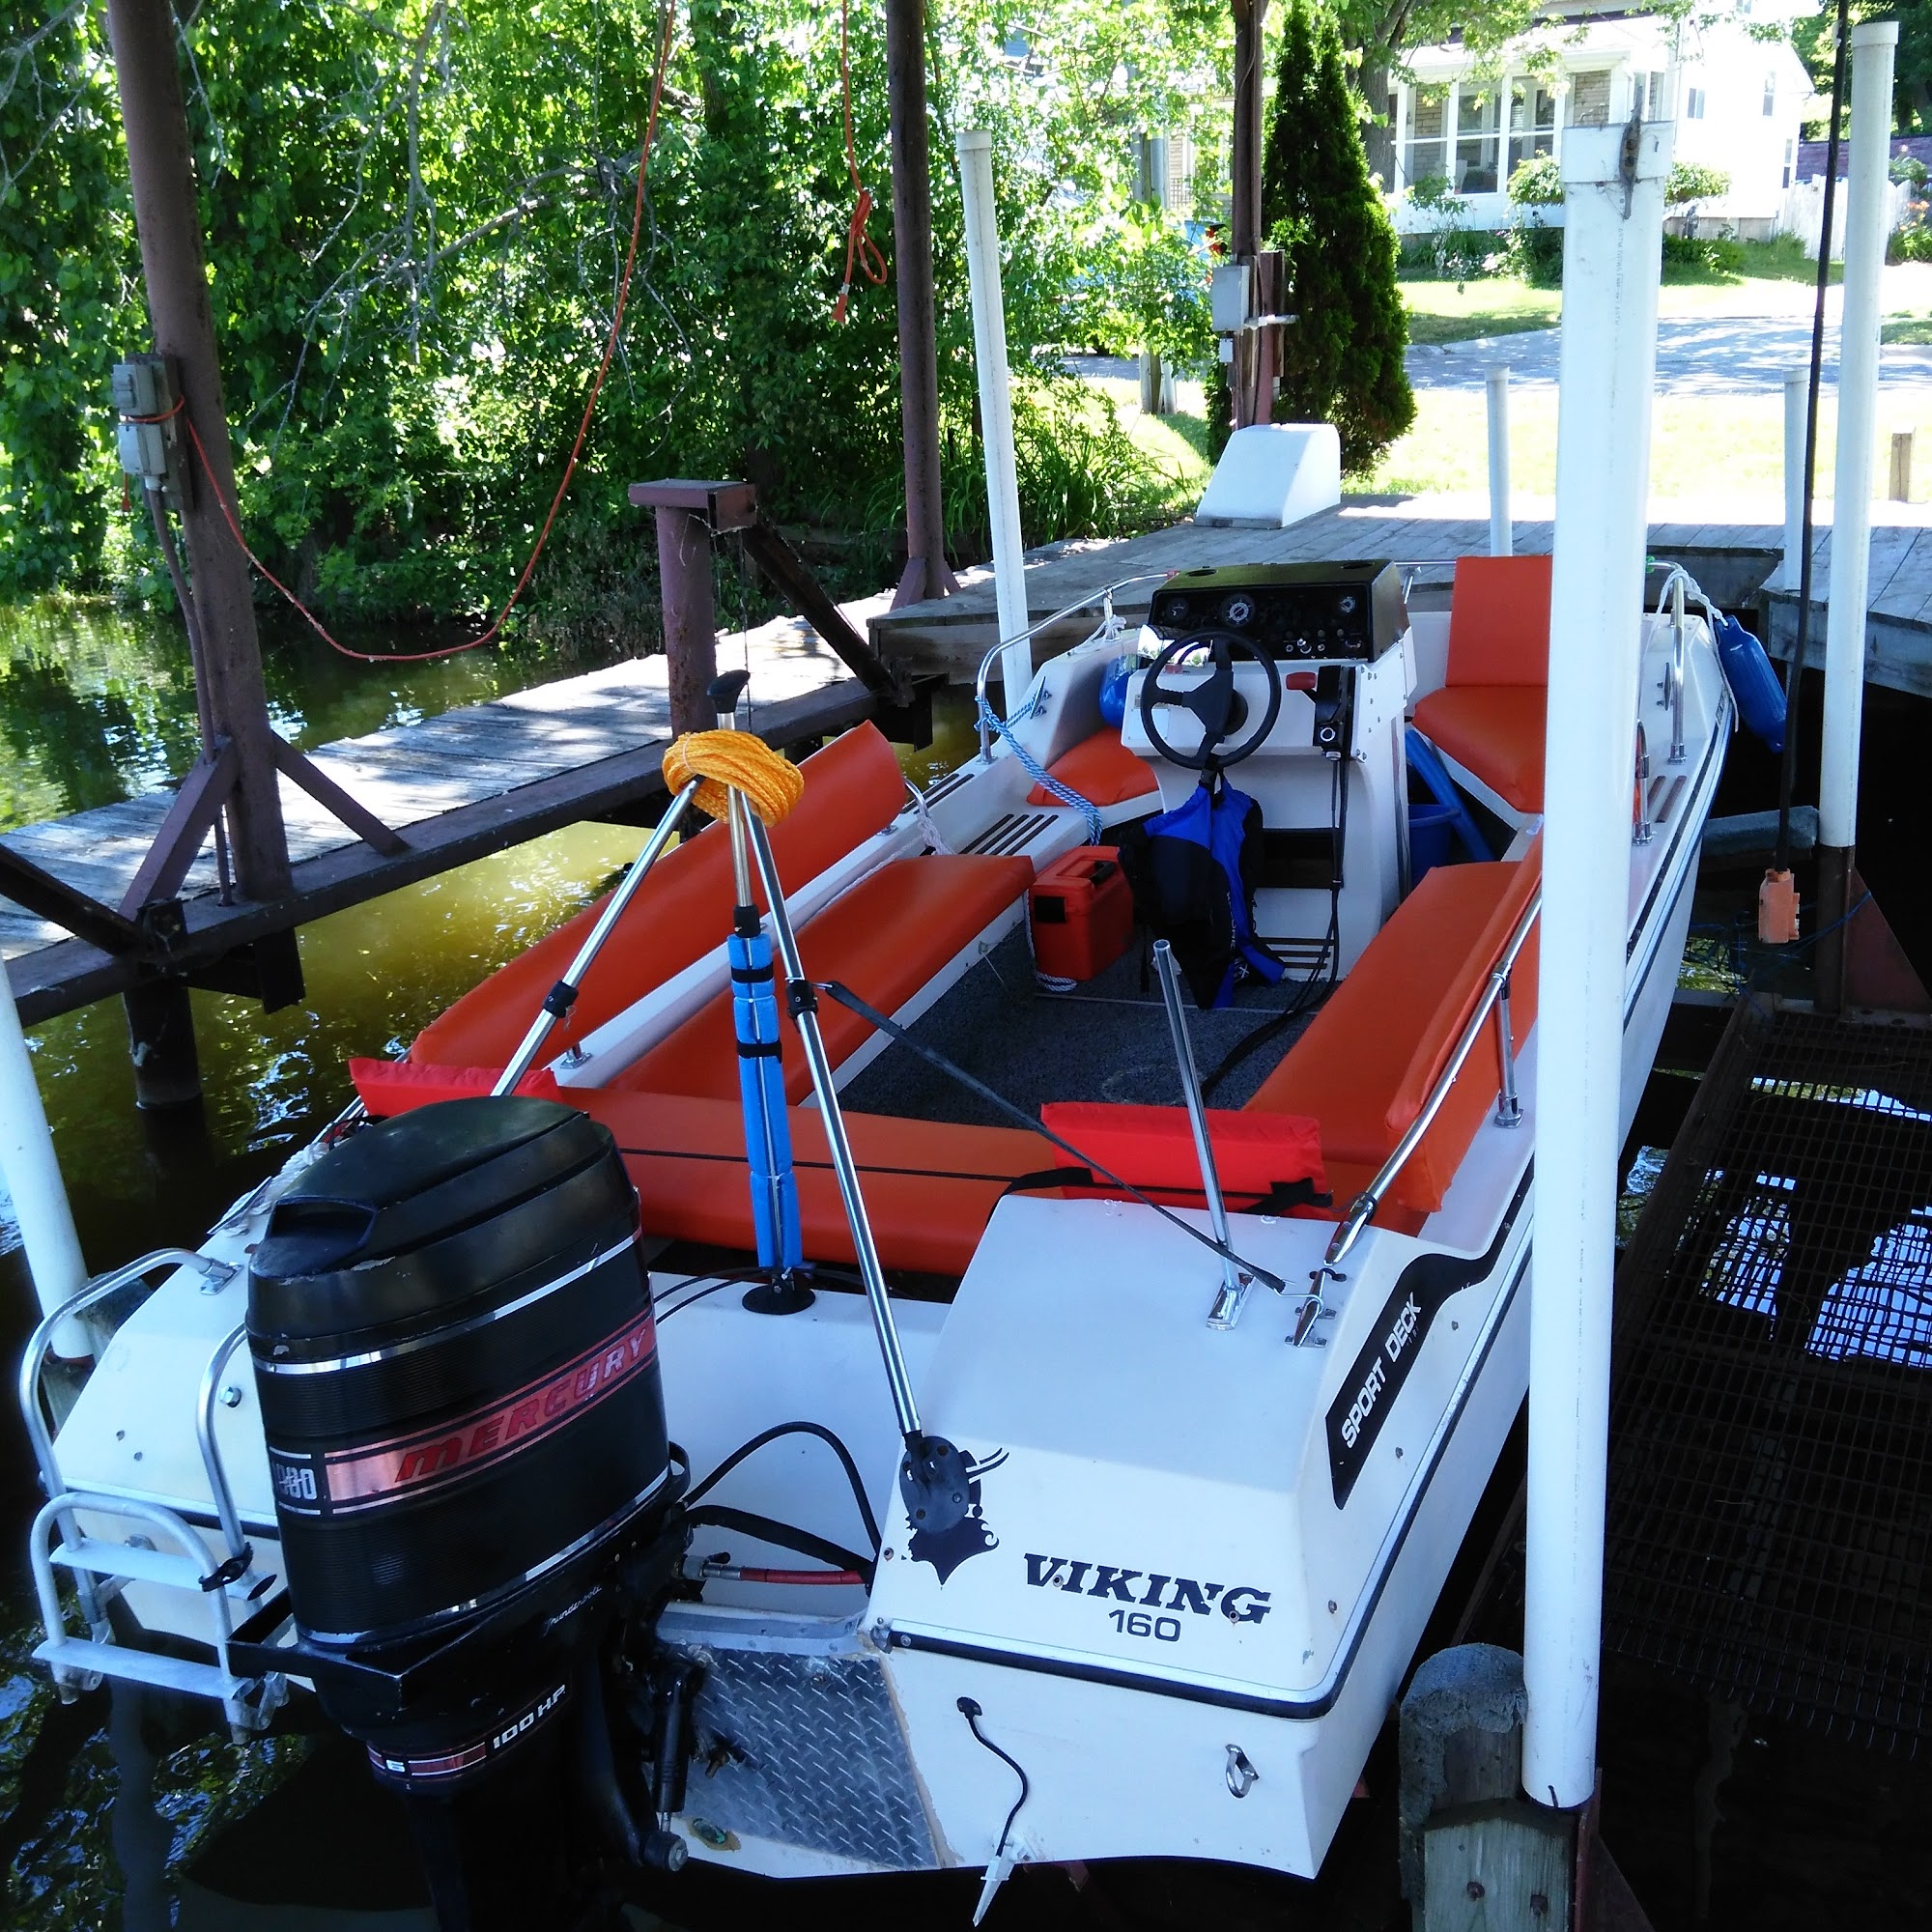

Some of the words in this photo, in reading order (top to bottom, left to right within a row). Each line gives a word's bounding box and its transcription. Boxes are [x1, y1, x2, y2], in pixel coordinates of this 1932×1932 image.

[1341, 1355, 1385, 1448] SPORT
[1385, 1292, 1421, 1363] DECK
[394, 1328, 646, 1483] MERCURY
[1023, 1552, 1271, 1624] VIKING
[1108, 1609, 1181, 1642] 160
[493, 1712, 534, 1749] 100
[386, 1759, 406, 1773] 6
